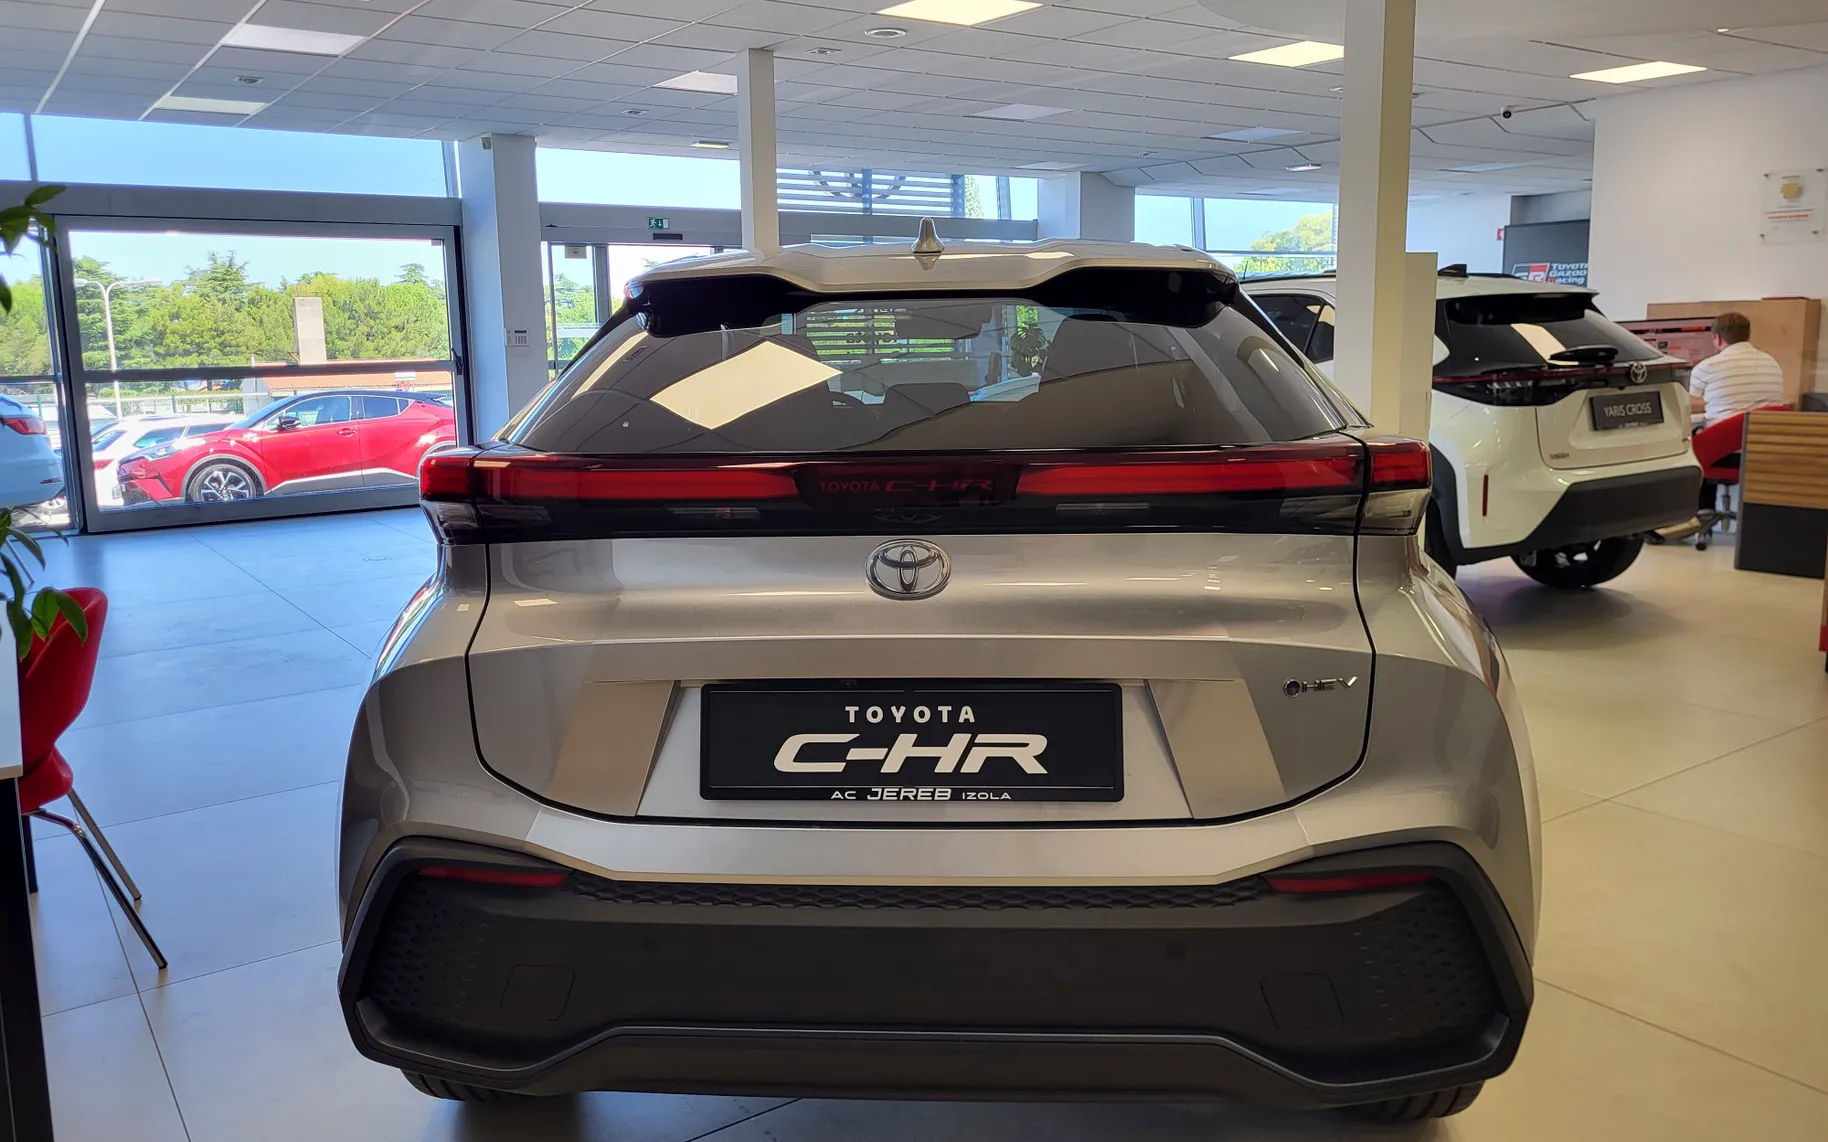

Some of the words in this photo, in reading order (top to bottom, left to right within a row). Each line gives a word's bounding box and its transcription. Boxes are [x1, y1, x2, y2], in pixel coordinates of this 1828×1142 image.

[1603, 405, 1626, 417] YARIS
[1626, 402, 1652, 416] CROSS
[820, 481, 880, 492] TOYOTA
[845, 705, 975, 723] TOYOTA
[774, 733, 1048, 774] C-HR
[830, 790, 857, 800] AC
[867, 788, 952, 801] JEREB
[962, 792, 1012, 800] IZOLA
